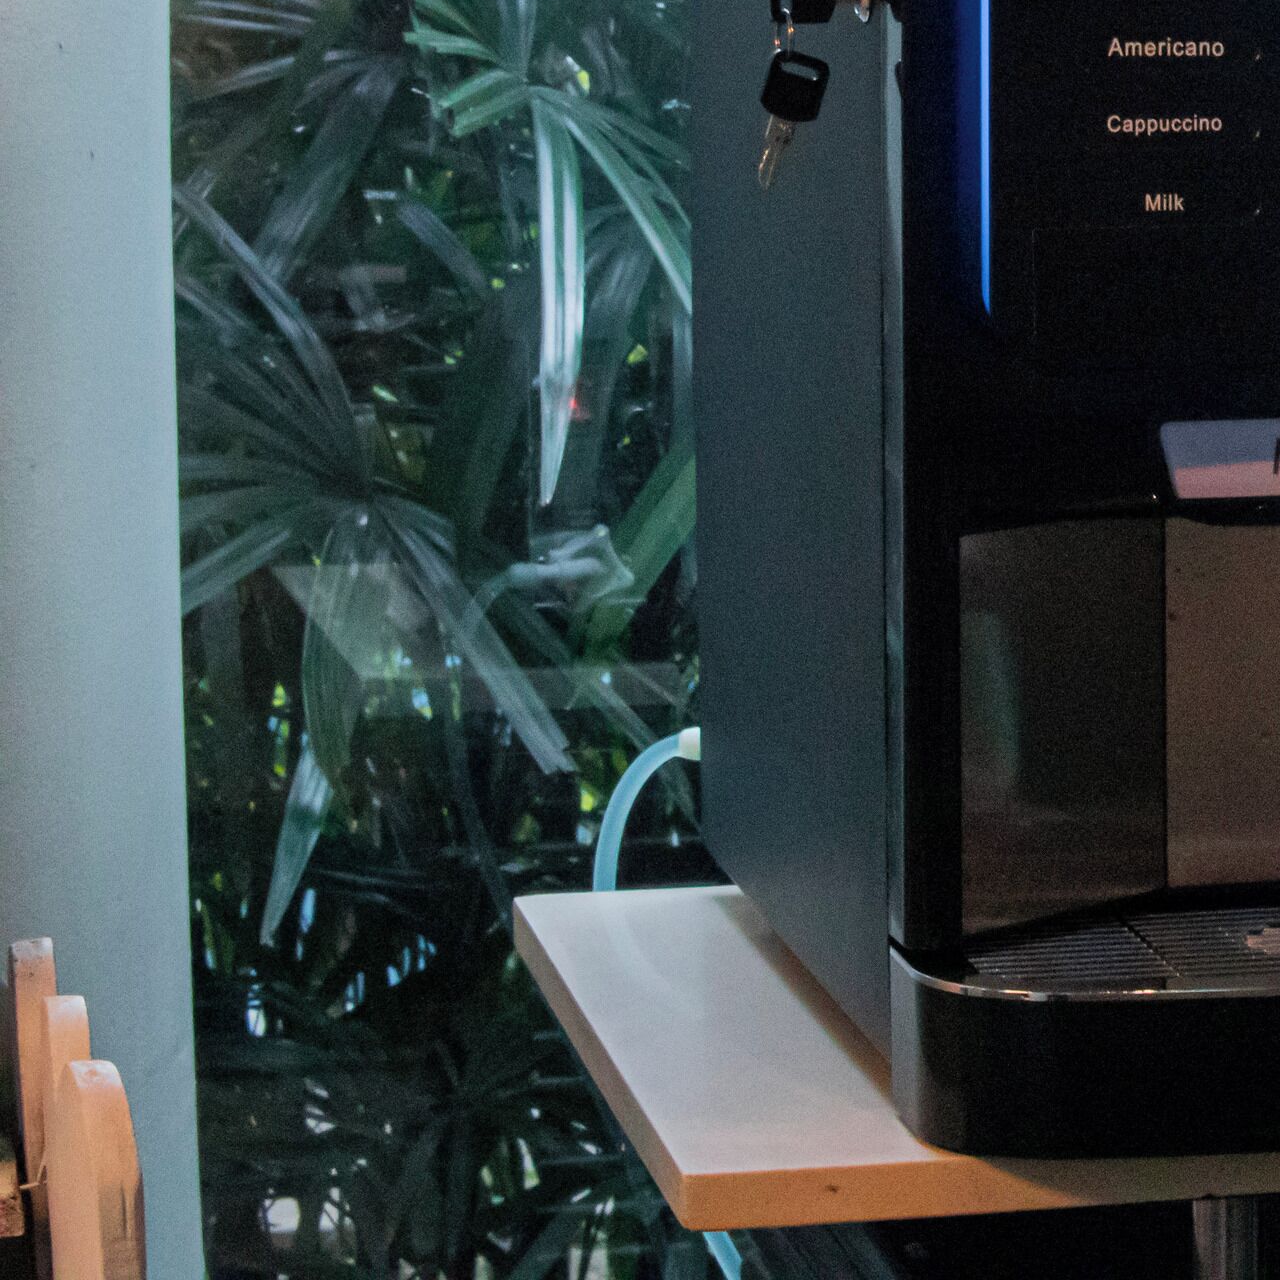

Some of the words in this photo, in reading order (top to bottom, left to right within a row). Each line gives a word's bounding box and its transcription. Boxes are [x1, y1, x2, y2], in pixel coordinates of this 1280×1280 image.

[1107, 36, 1225, 57] Americano
[1106, 114, 1223, 137] Cappuccino
[1144, 192, 1185, 212] Milk
